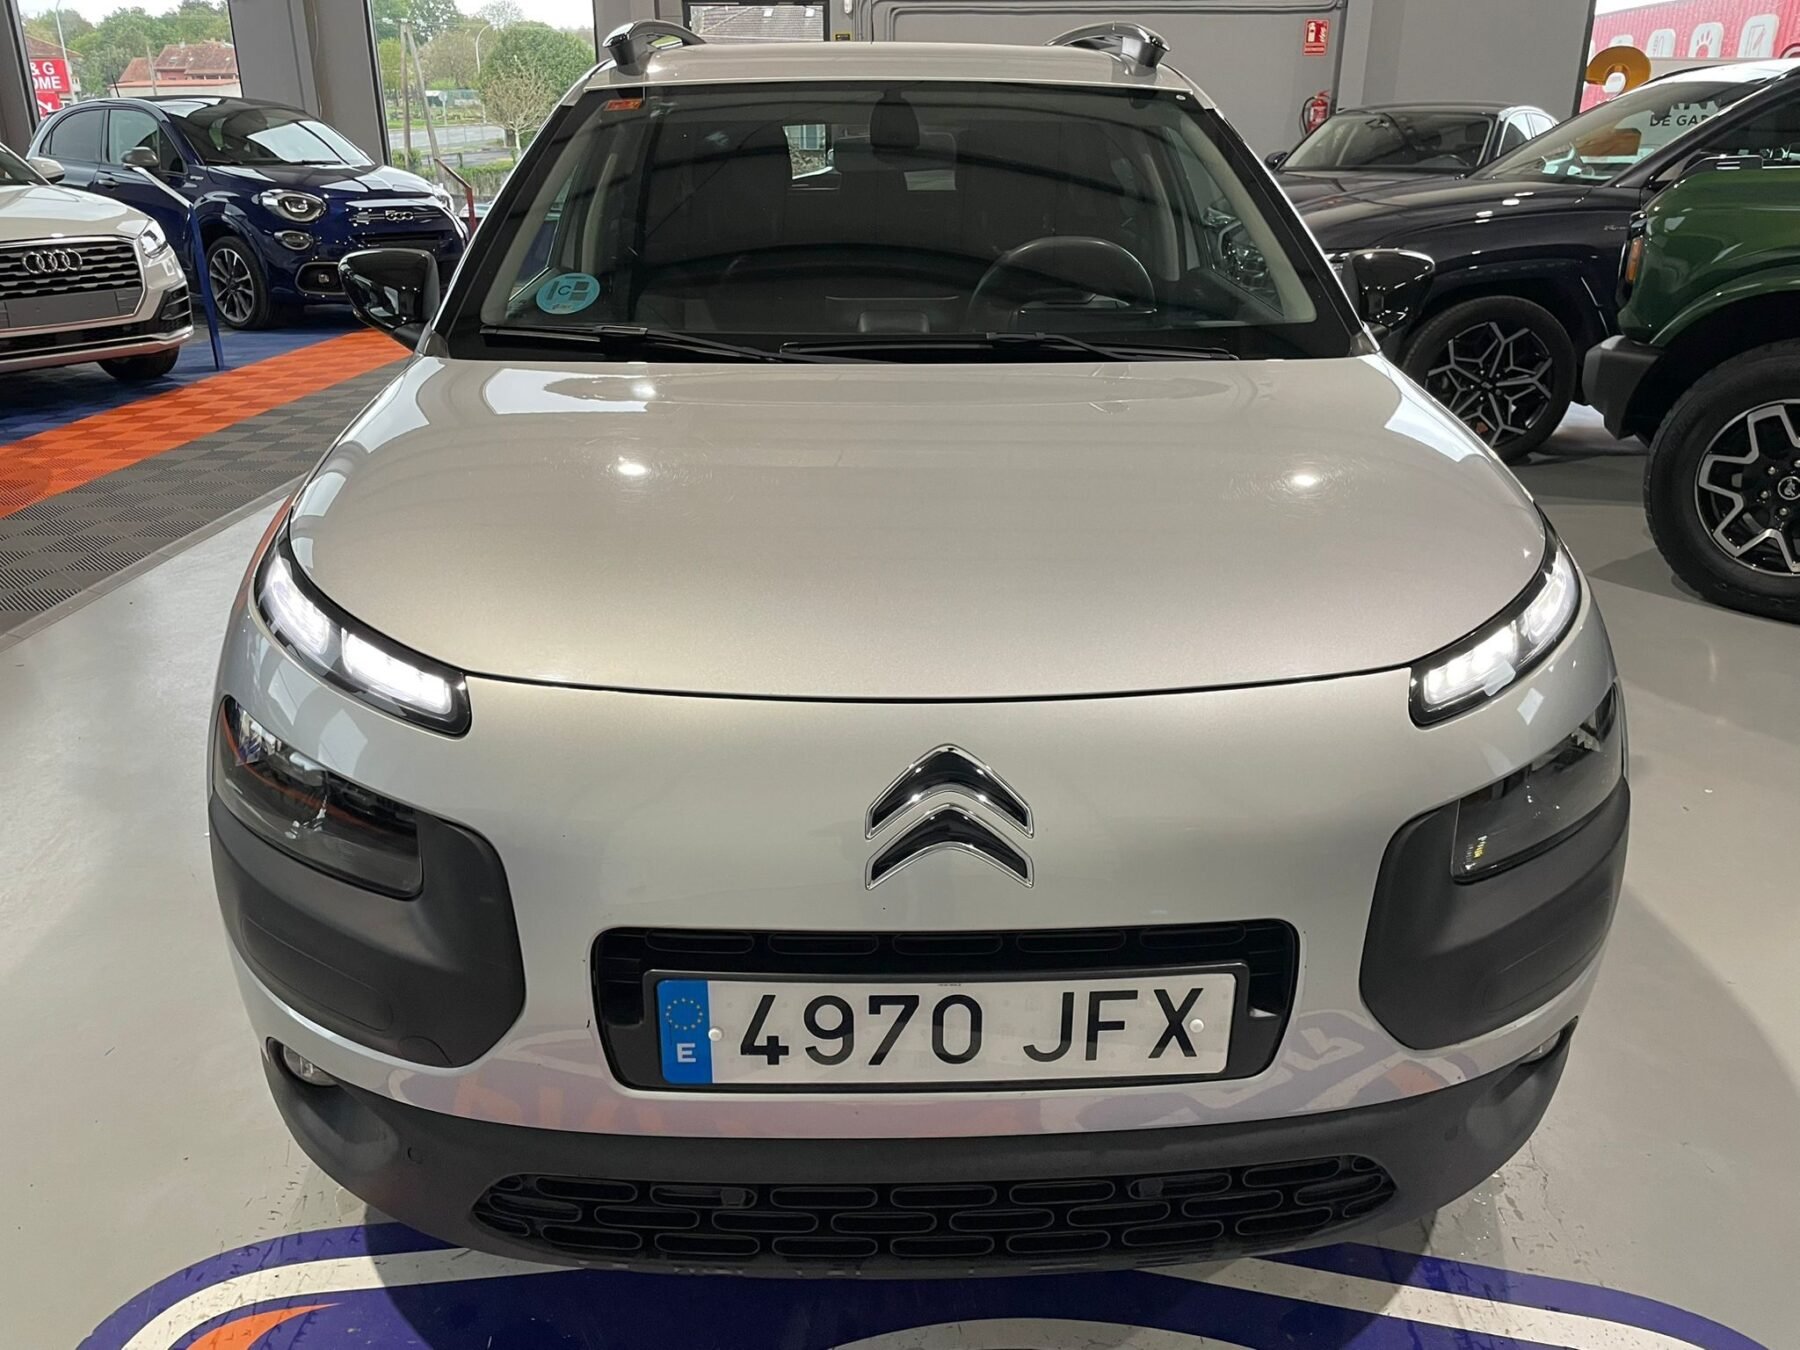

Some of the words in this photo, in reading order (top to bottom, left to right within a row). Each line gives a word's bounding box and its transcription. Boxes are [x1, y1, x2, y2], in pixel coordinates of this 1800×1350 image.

[43, 62, 55, 75] G
[740, 994, 983, 1066] 4970
[1022, 987, 1203, 1064] JFX
[677, 1043, 696, 1063] E
